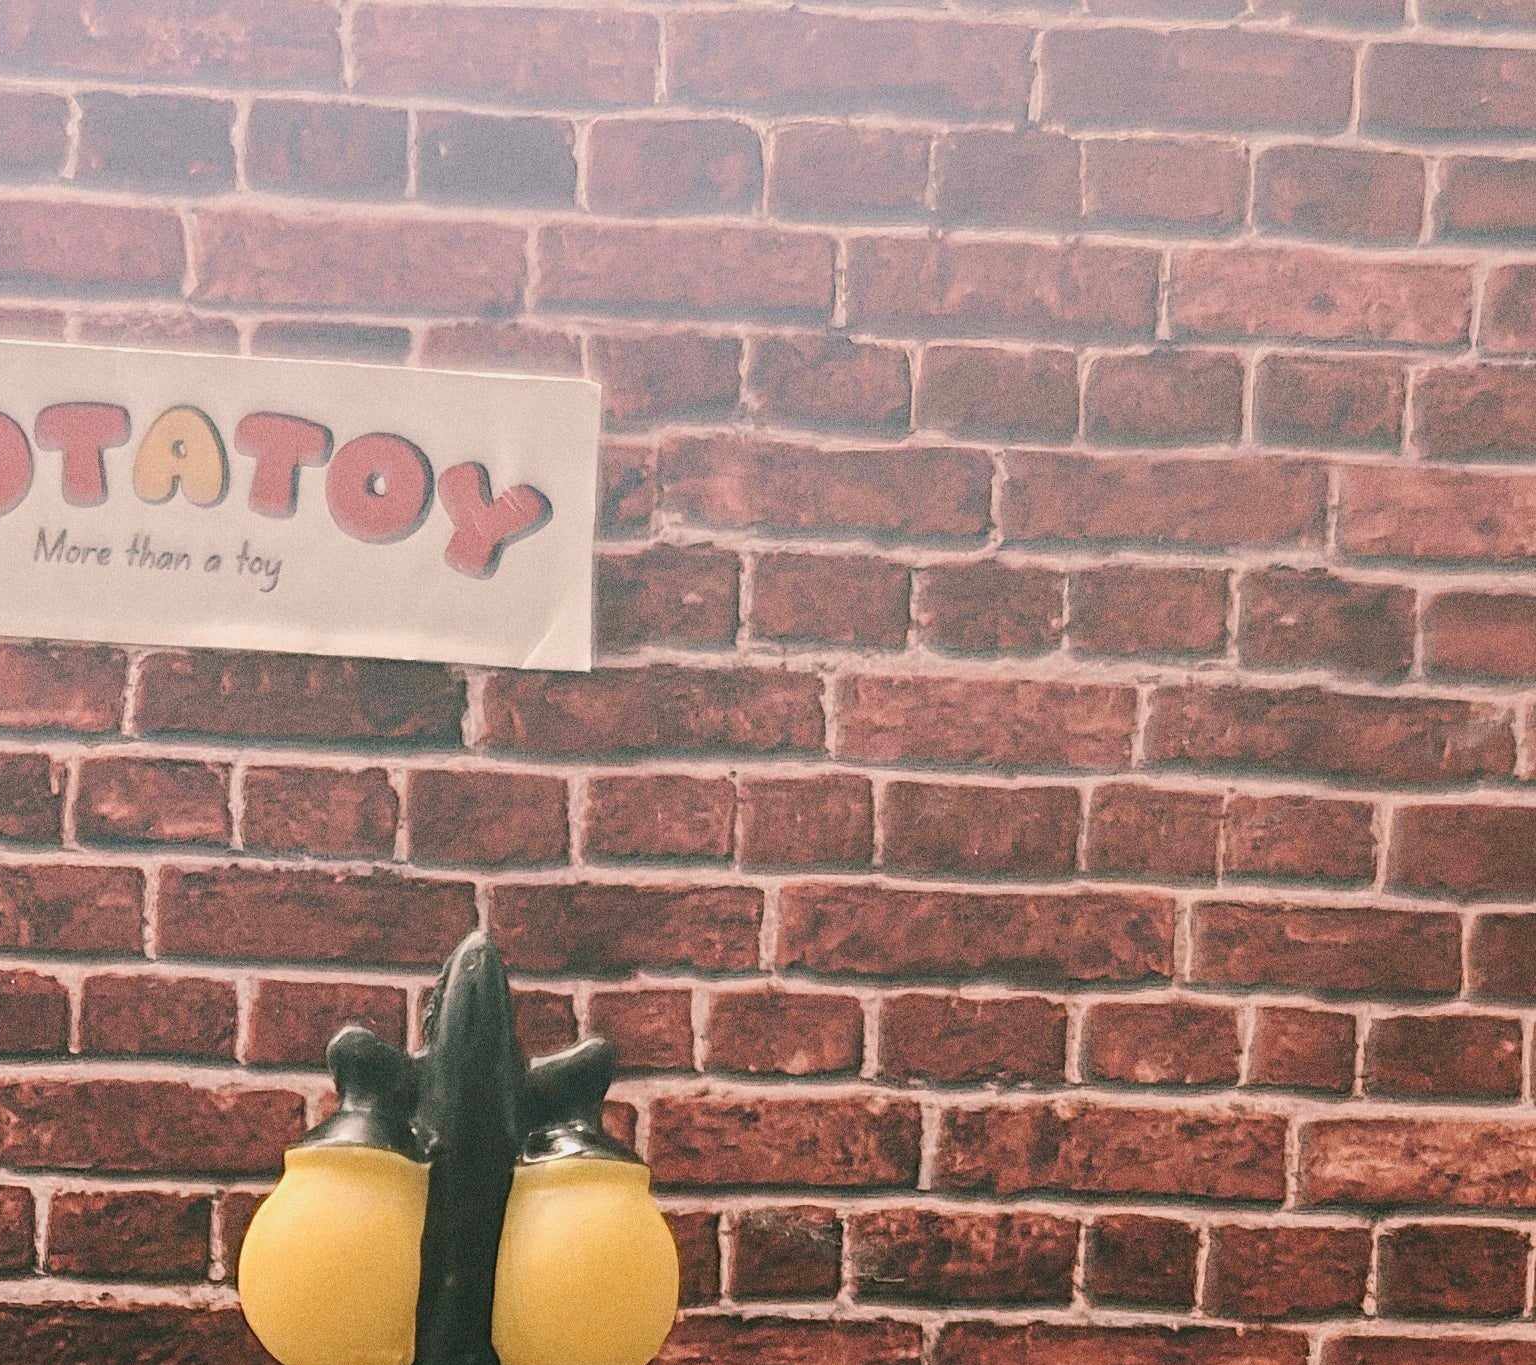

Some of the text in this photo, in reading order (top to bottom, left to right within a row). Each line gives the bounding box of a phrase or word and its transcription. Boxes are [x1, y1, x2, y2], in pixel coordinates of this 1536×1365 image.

[33, 526, 283, 593] More than a toy
